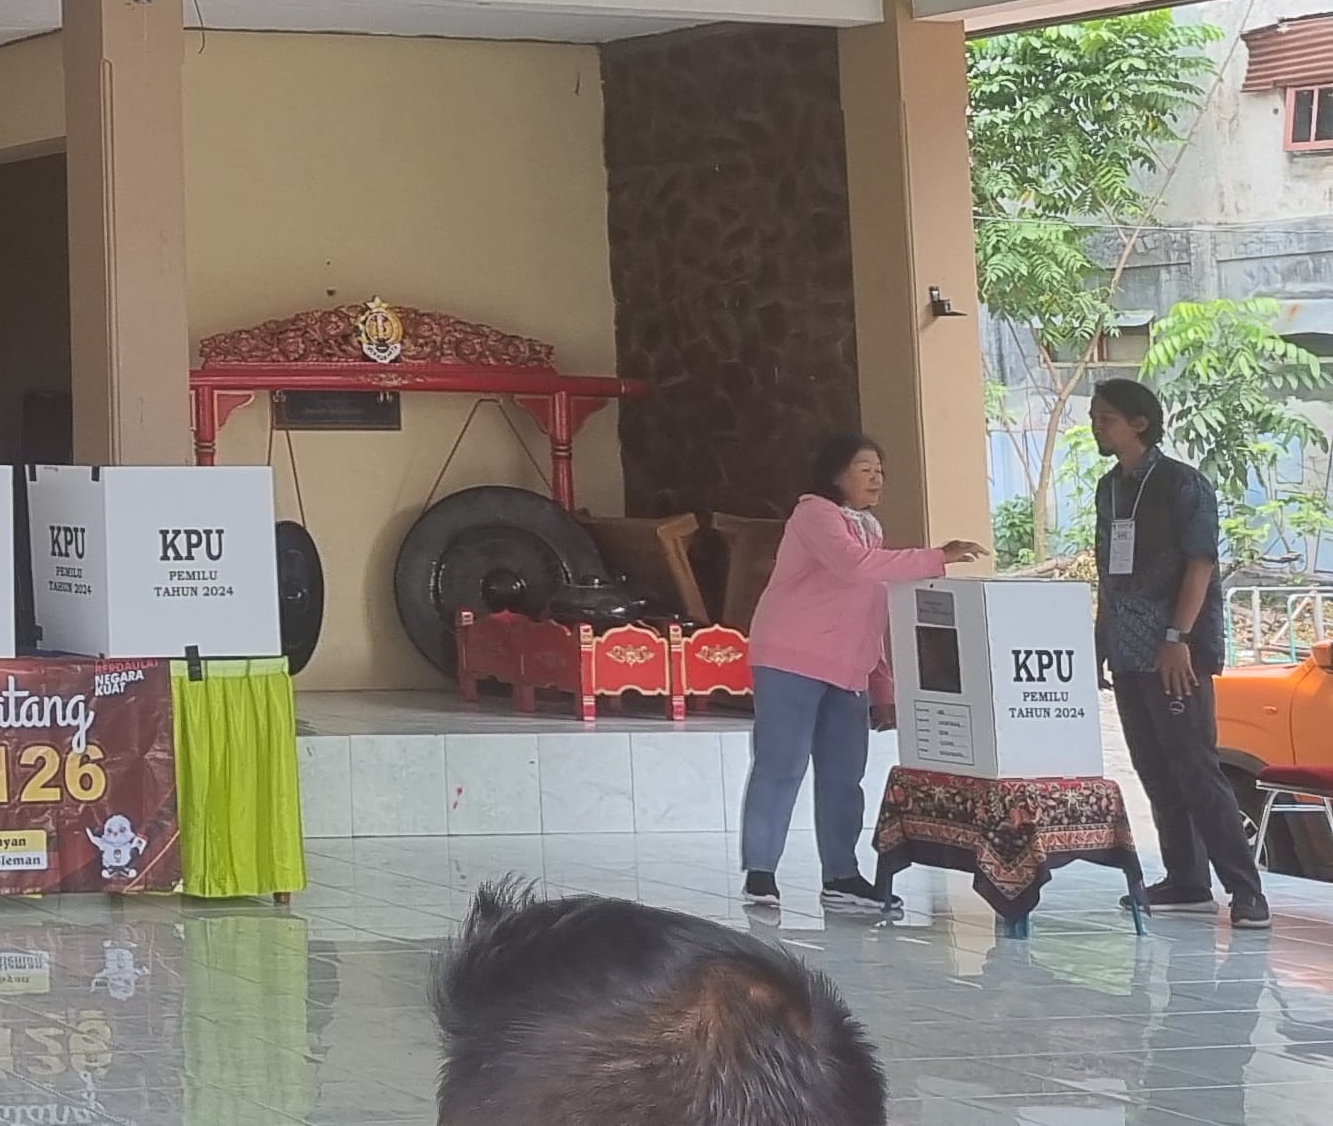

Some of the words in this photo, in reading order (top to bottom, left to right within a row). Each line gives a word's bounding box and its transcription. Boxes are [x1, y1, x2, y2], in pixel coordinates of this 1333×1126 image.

[49, 525, 85, 559] KPU
[159, 529, 224, 561] KPU
[169, 570, 218, 581] PEMILU
[154, 586, 198, 597] TAHUN
[202, 586, 234, 596] 2024
[1011, 649, 1074, 683] KPU
[95, 669, 144, 685] NEGARA
[95, 682, 126, 696] KUAT
[1022, 692, 1069, 702] PEMILU
[1008, 708, 1051, 718] TAHUN
[1054, 708, 1085, 718] 2024
